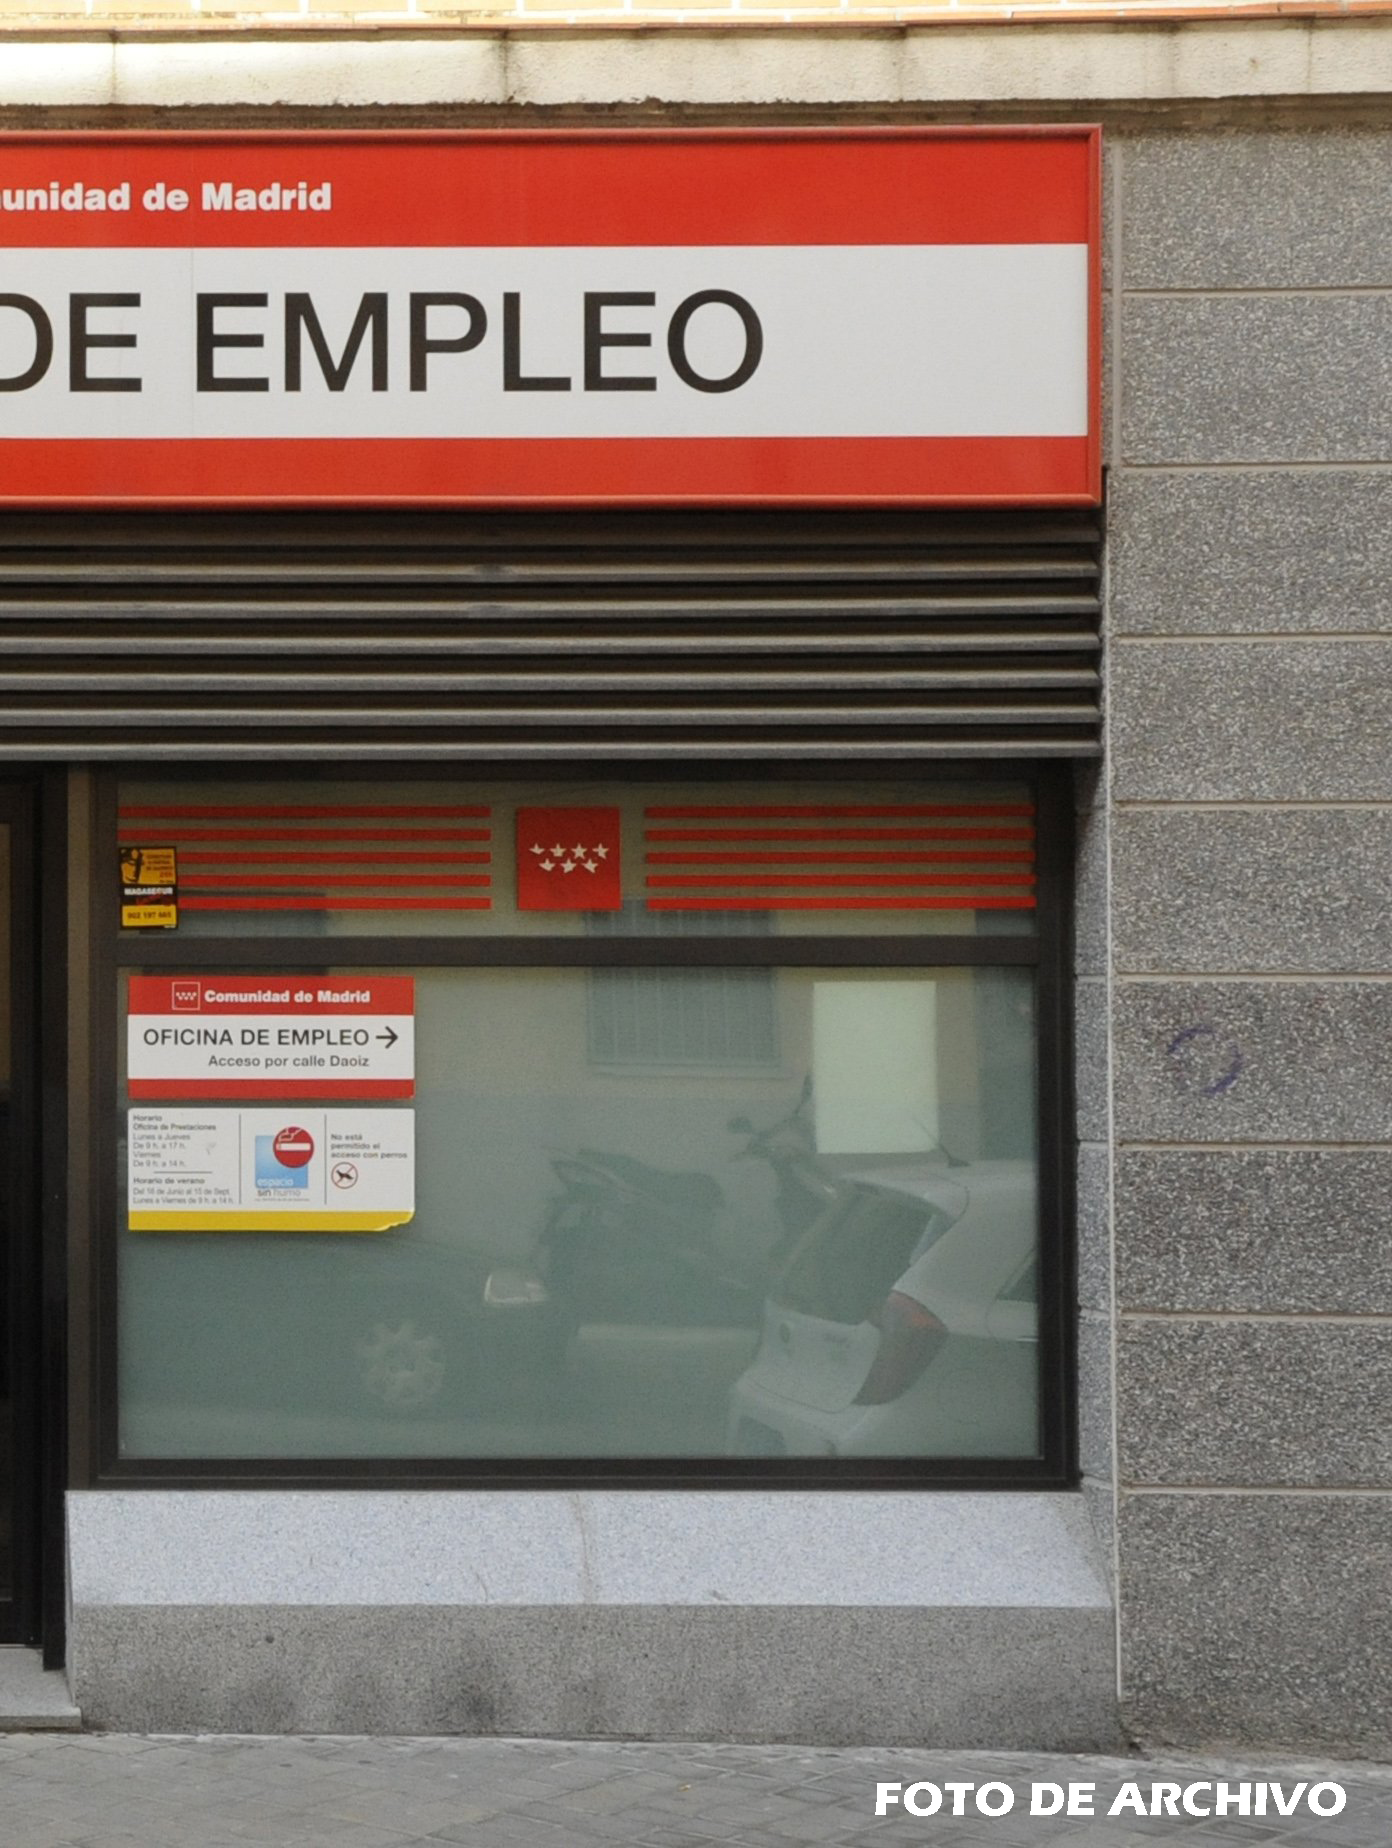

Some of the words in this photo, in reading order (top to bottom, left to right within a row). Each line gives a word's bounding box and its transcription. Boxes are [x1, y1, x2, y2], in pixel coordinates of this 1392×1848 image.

[143, 183, 188, 210] de
[203, 183, 330, 210] Madrid
[197, 290, 762, 393] EMPLEO
[204, 990, 290, 1003] Comunidad
[294, 990, 313, 1003] de
[317, 990, 371, 1003] Madrid
[143, 1028, 234, 1046] OFICINA
[241, 1028, 270, 1046] DE
[277, 1028, 370, 1046] EMPLEO
[208, 1055, 261, 1067] Acceso
[264, 1057, 288, 1070] por
[292, 1054, 326, 1067] calle
[329, 1055, 370, 1067] Daoiz
[345, 1133, 363, 1141] está
[331, 1142, 370, 1150] permitido
[380, 1152, 407, 1160] perros
[257, 1178, 294, 1187] espacio
[257, 1188, 272, 1197] sin
[273, 1188, 301, 1197] humo
